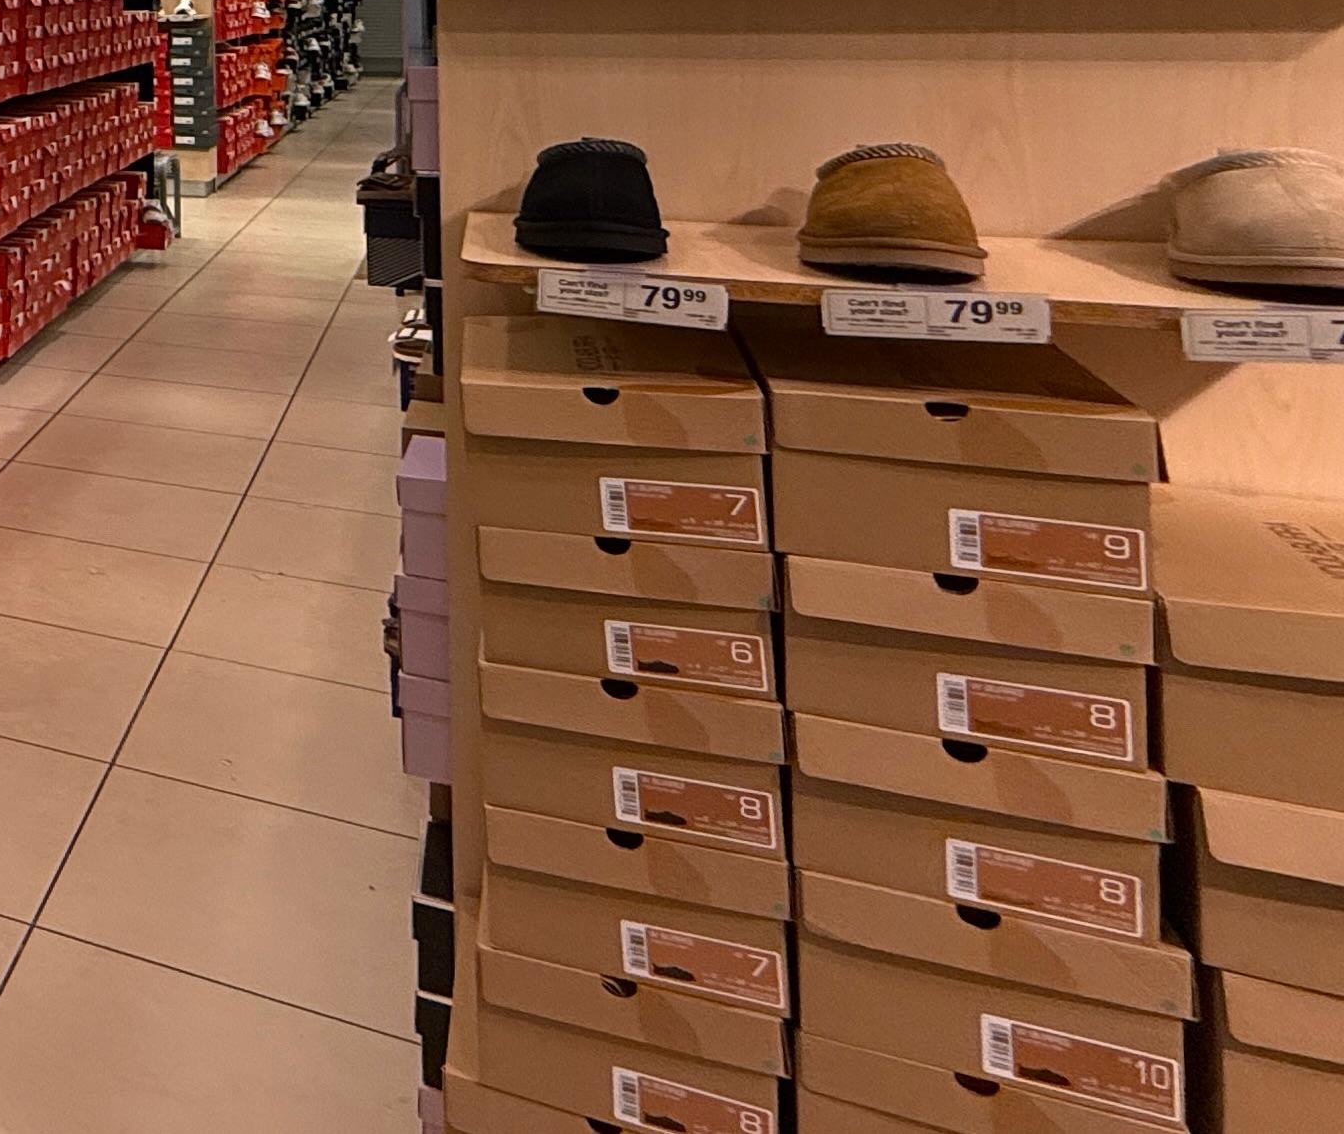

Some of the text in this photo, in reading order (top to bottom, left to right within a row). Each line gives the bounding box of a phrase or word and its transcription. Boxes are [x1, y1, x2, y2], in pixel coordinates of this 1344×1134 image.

[559, 288, 583, 296] your
[587, 280, 608, 289] find
[849, 308, 877, 316] your
[882, 299, 906, 307] find
[1215, 329, 1247, 338] your
[1255, 320, 1284, 329] find
[725, 494, 748, 515] 7
[1103, 534, 1131, 559] 9
[731, 641, 753, 664] 6
[1090, 704, 1116, 729] 8
[739, 796, 762, 820] 8
[1099, 878, 1127, 905] 8
[747, 954, 769, 978] 7
[1134, 1059, 1169, 1090] 10
[739, 1111, 761, 1134] 8
